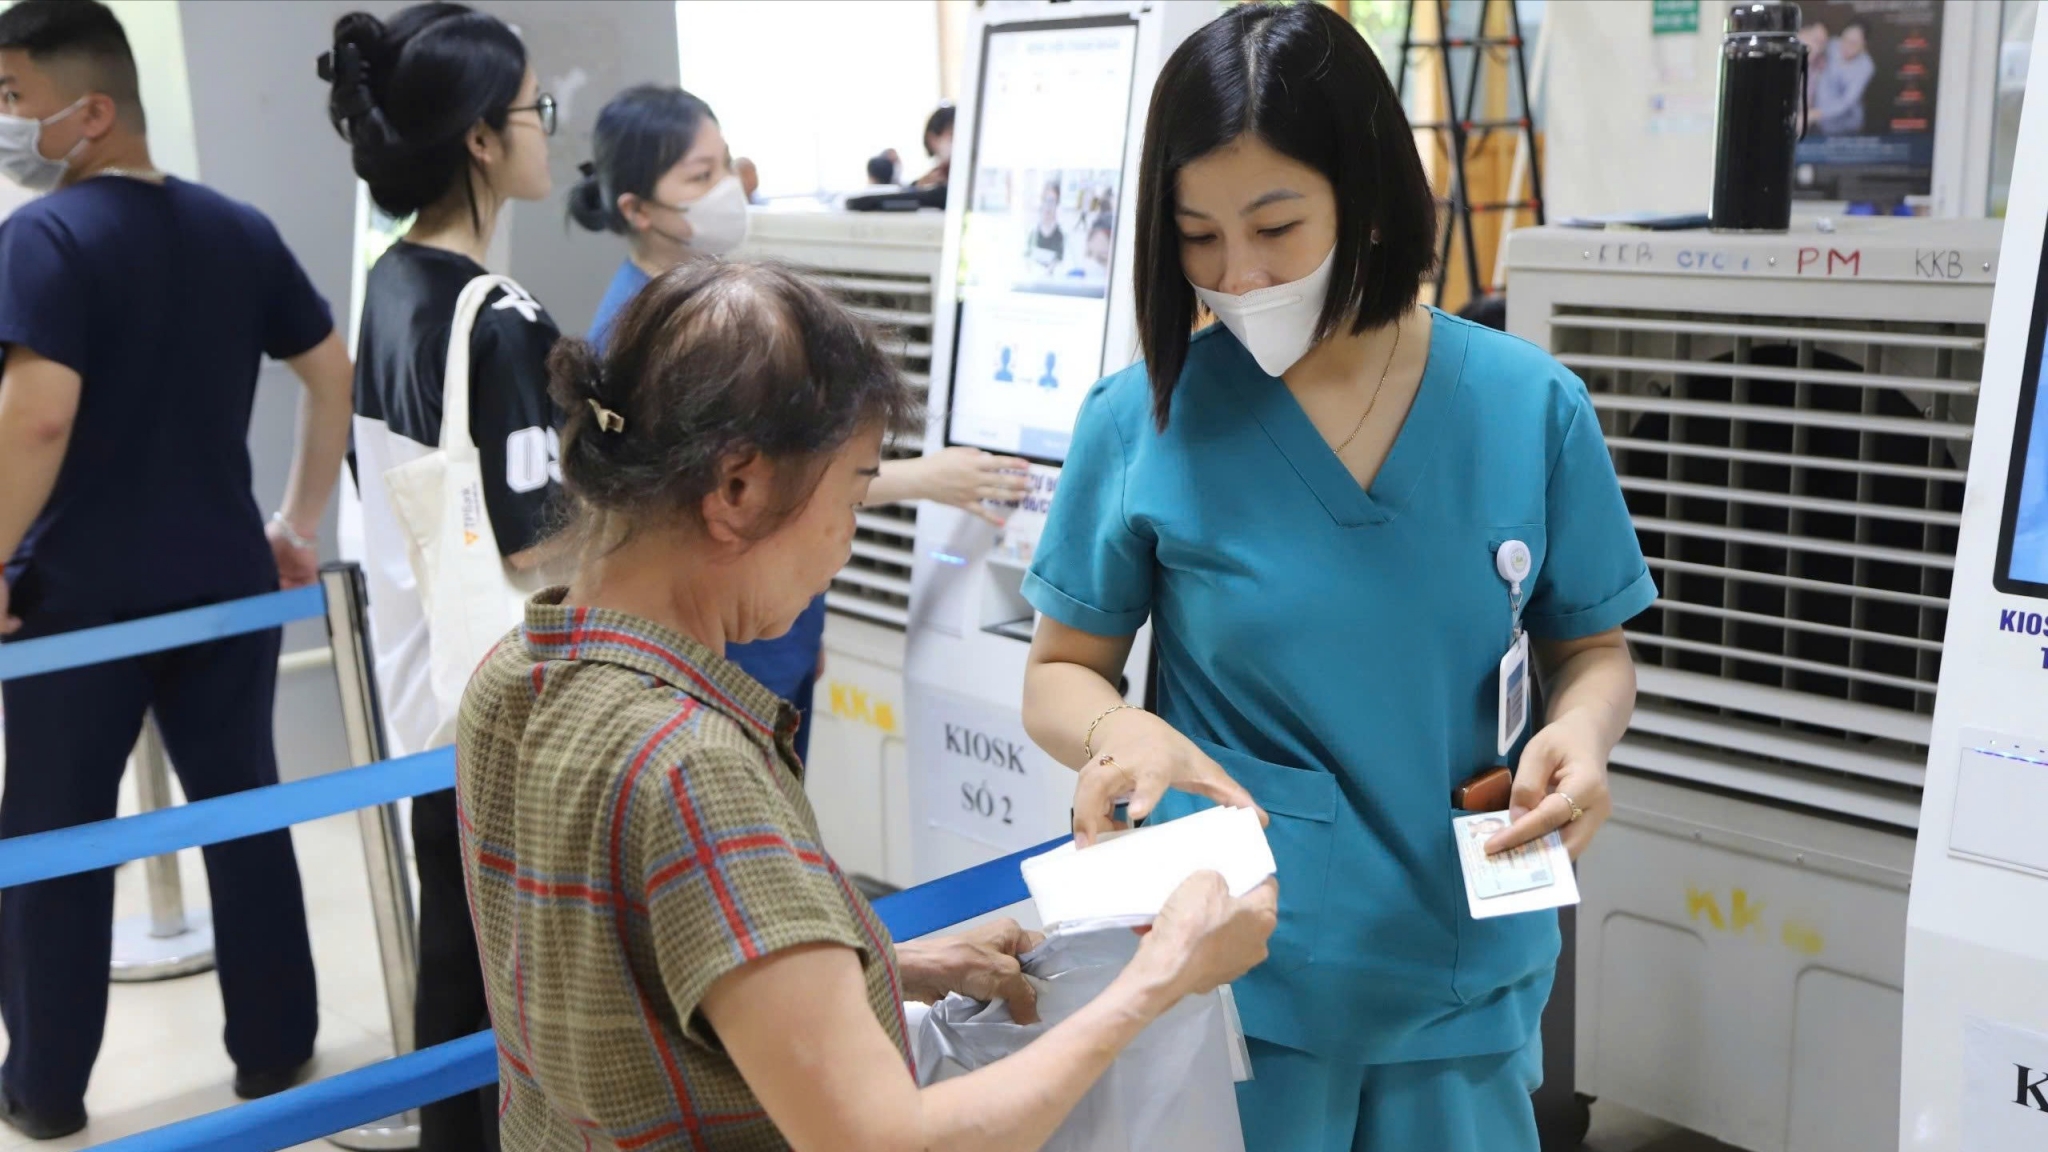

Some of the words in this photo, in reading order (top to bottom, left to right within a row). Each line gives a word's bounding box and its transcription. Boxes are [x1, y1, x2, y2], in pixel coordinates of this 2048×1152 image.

[1915, 248, 1963, 279] KKB
[945, 723, 1026, 775] KIOSK
[1001, 796, 1013, 824] 2
